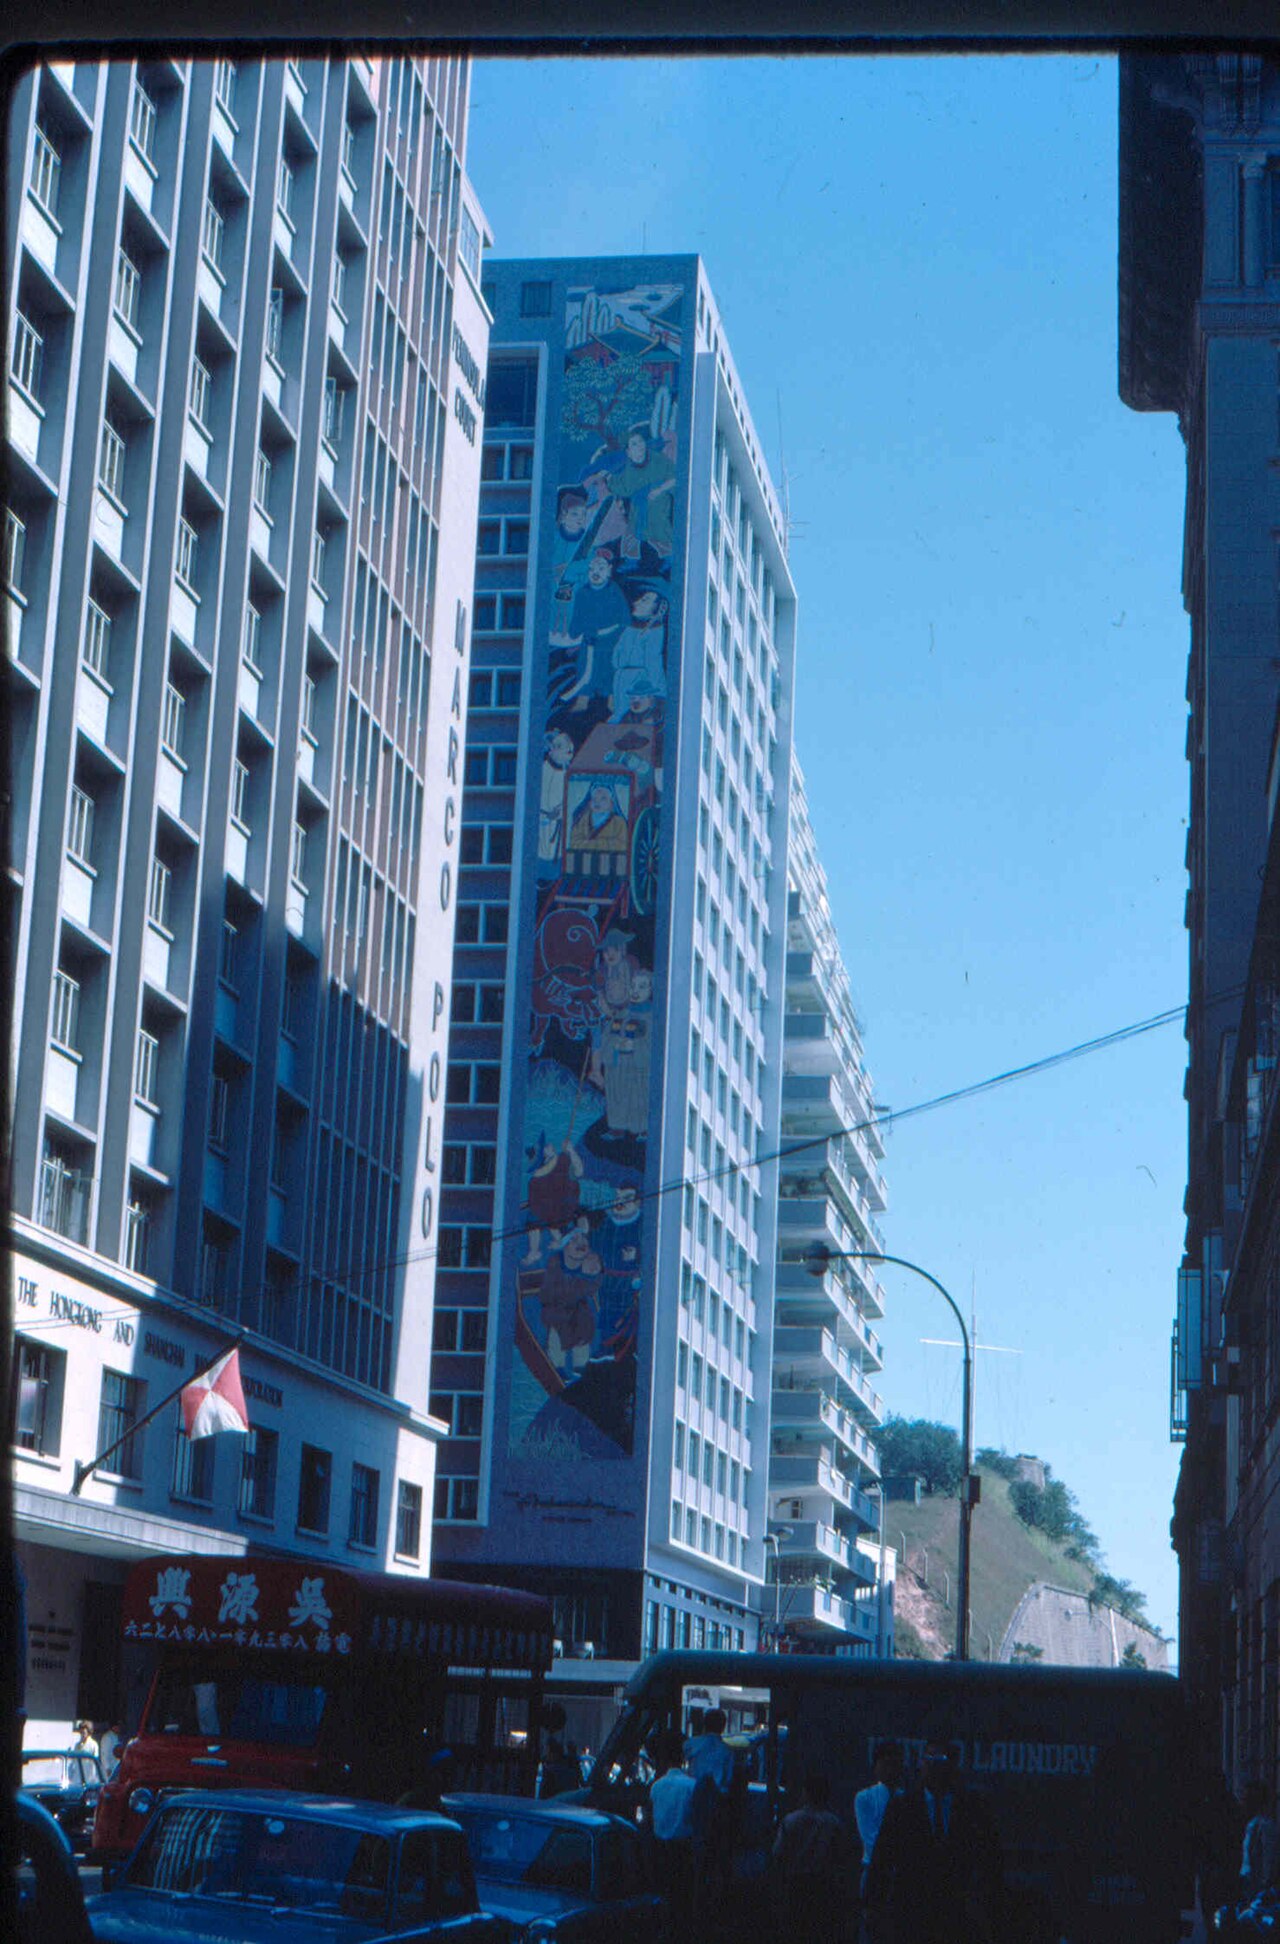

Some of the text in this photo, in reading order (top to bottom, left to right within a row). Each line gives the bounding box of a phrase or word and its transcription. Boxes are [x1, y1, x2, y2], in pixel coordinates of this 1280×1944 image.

[422, 598, 467, 1239] MARCO POLO
[18, 1276, 38, 1307] THE
[113, 1319, 134, 1346] AND
[971, 1739, 1098, 1777] LAUNDRY
